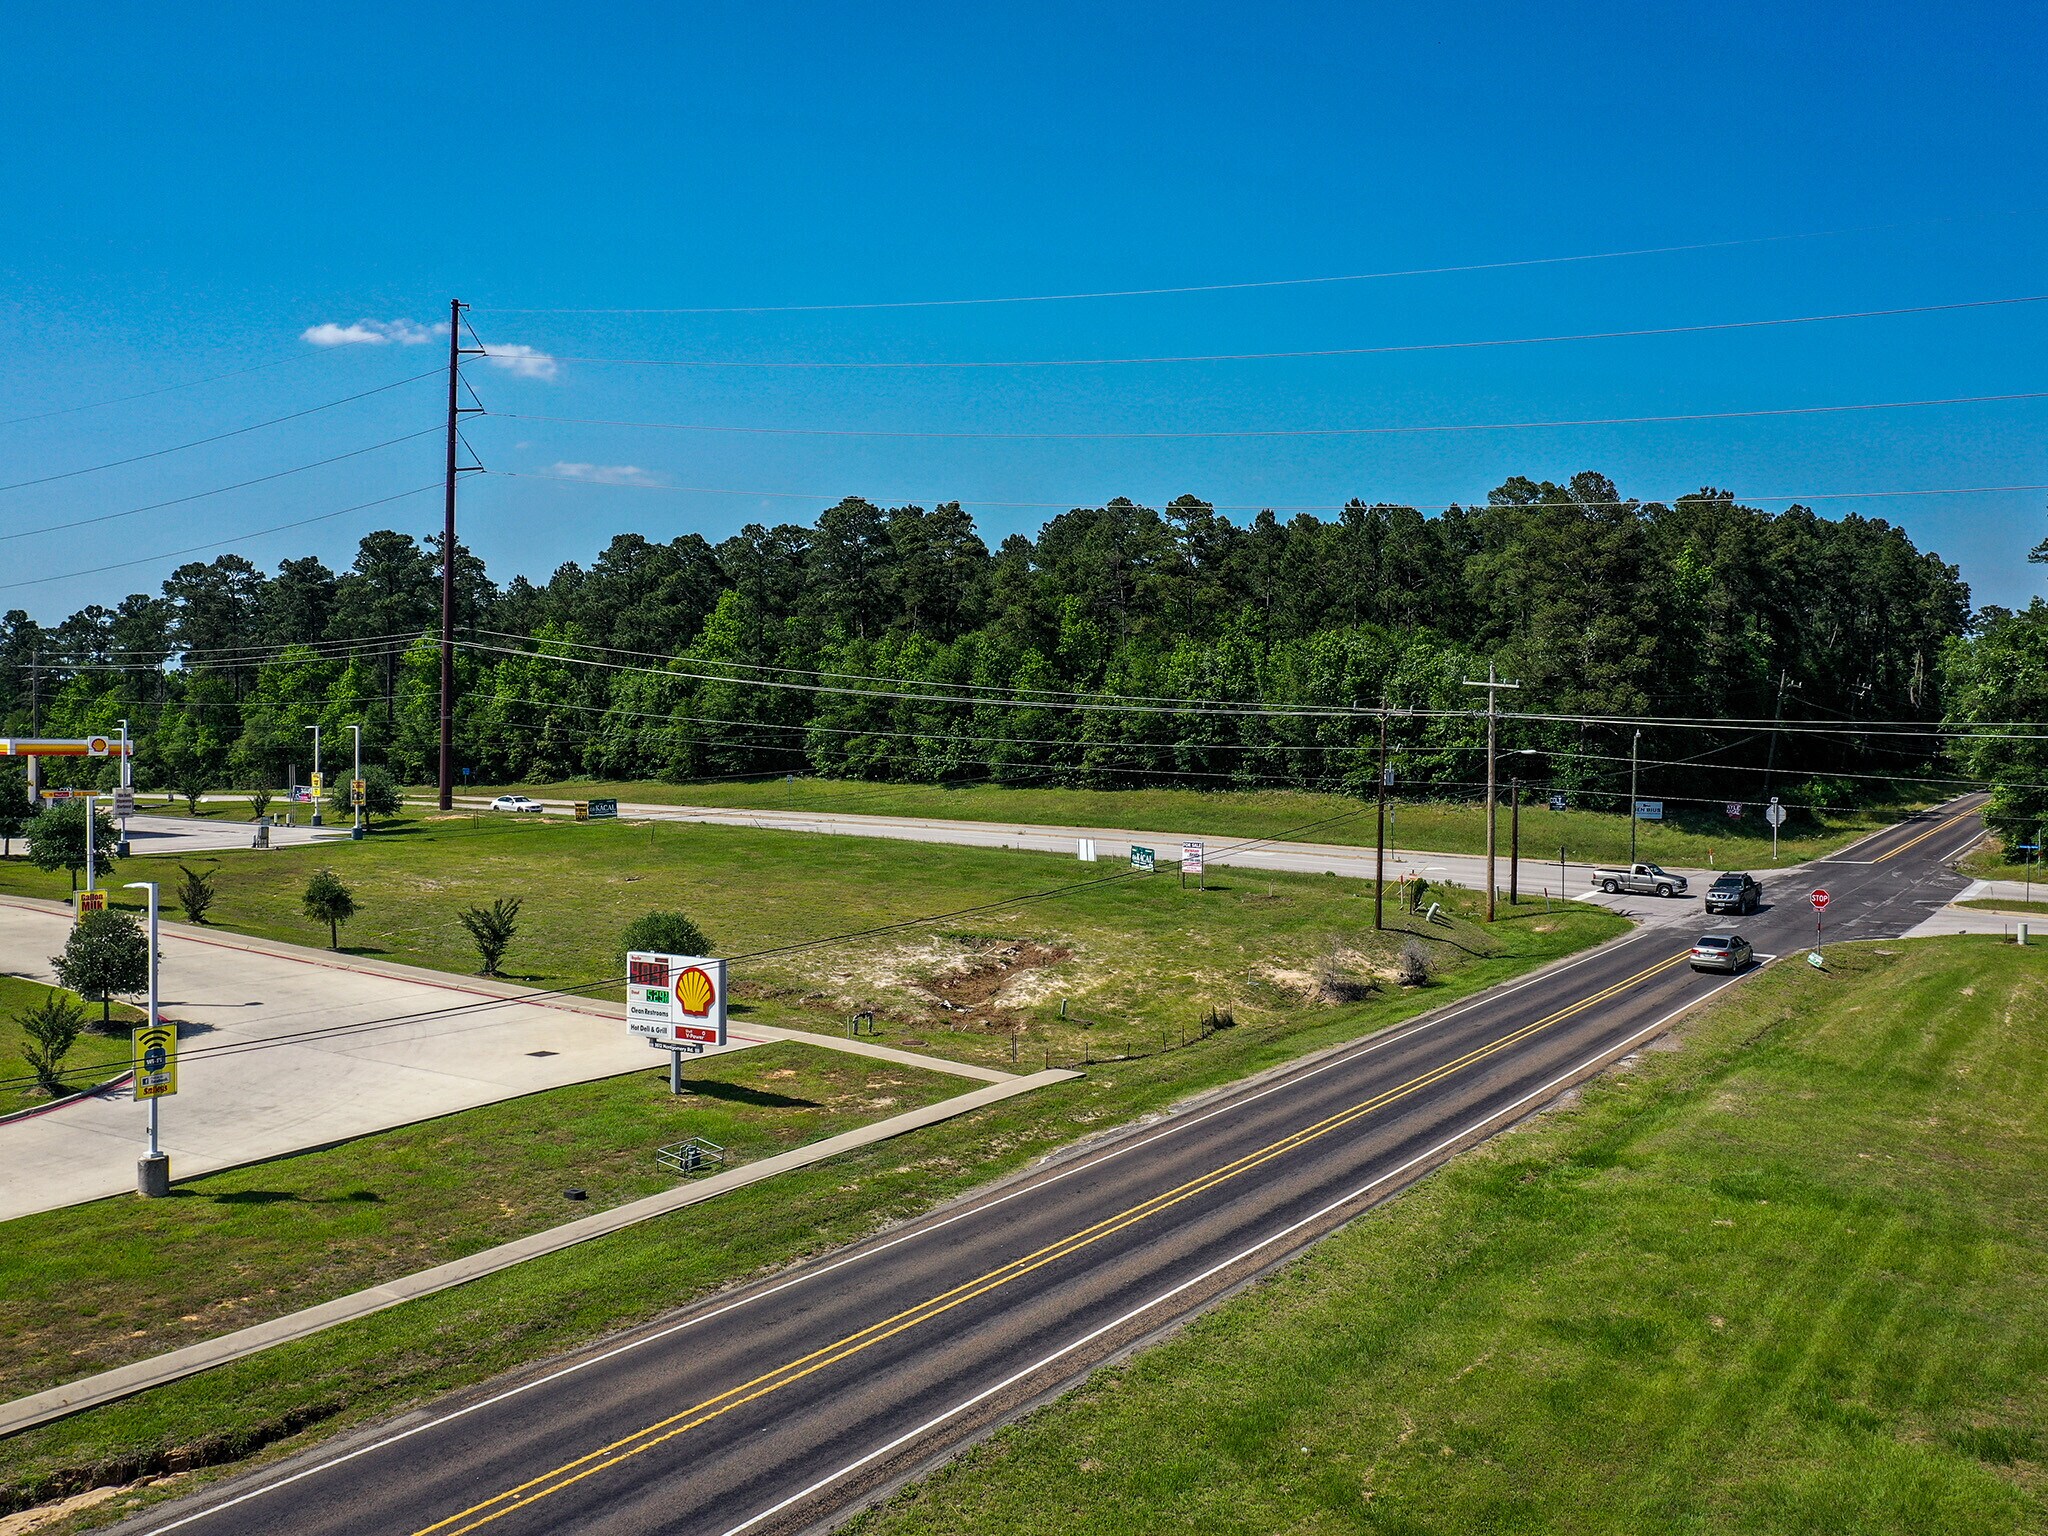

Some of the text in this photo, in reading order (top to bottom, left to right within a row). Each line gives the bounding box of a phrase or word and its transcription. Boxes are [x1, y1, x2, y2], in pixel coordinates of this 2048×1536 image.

[1811, 894, 1828, 902] STOP
[82, 901, 103, 912] Milk
[645, 1008, 669, 1017] Restrooms
